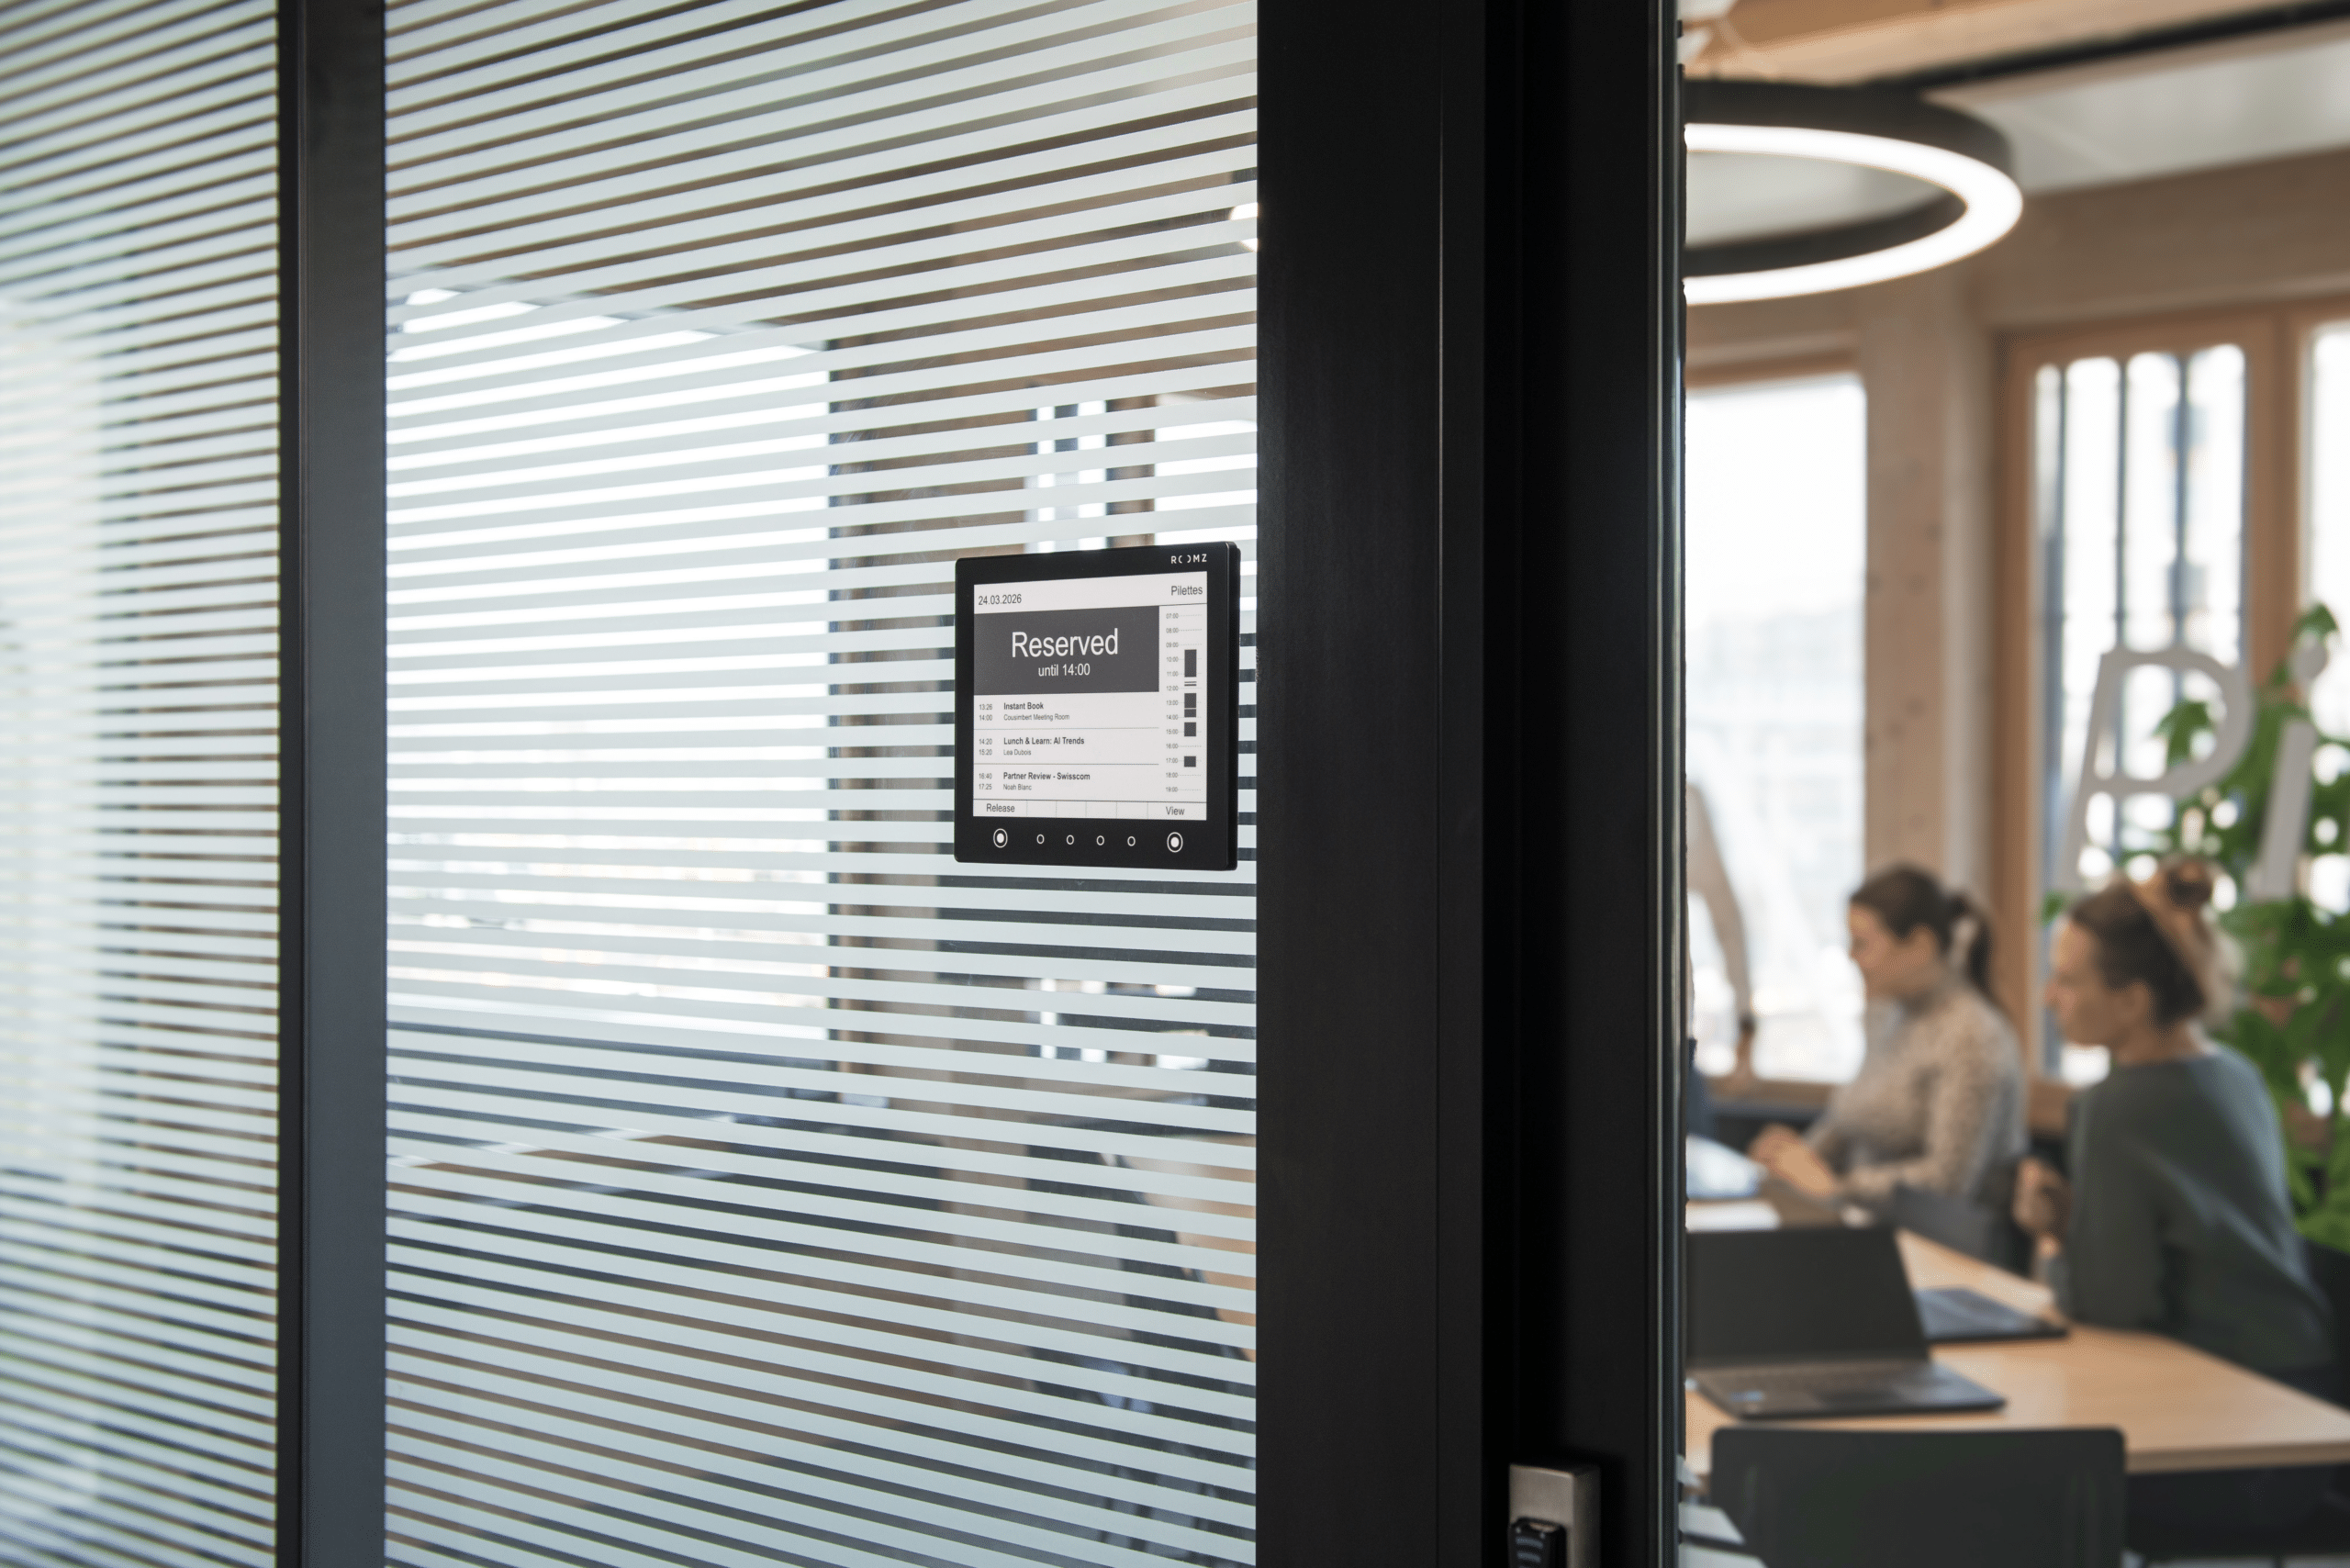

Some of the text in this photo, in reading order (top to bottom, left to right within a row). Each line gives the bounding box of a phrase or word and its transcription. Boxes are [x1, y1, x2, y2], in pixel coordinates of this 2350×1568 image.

[1170, 585, 1203, 597] Pilettes
[978, 593, 1023, 606] 24.03.2026
[1012, 627, 1119, 658] Reserved
[1038, 663, 1091, 677] until 14:00
[1003, 701, 1044, 711] Instant Book
[1033, 713, 1054, 722] Meeting
[1062, 736, 1085, 745] Trends
[1003, 772, 1026, 780] Partner
[1028, 772, 1051, 780] Review
[1057, 772, 1091, 780] Swisscom
[986, 802, 1015, 814] Release
[1165, 806, 1185, 816] View
